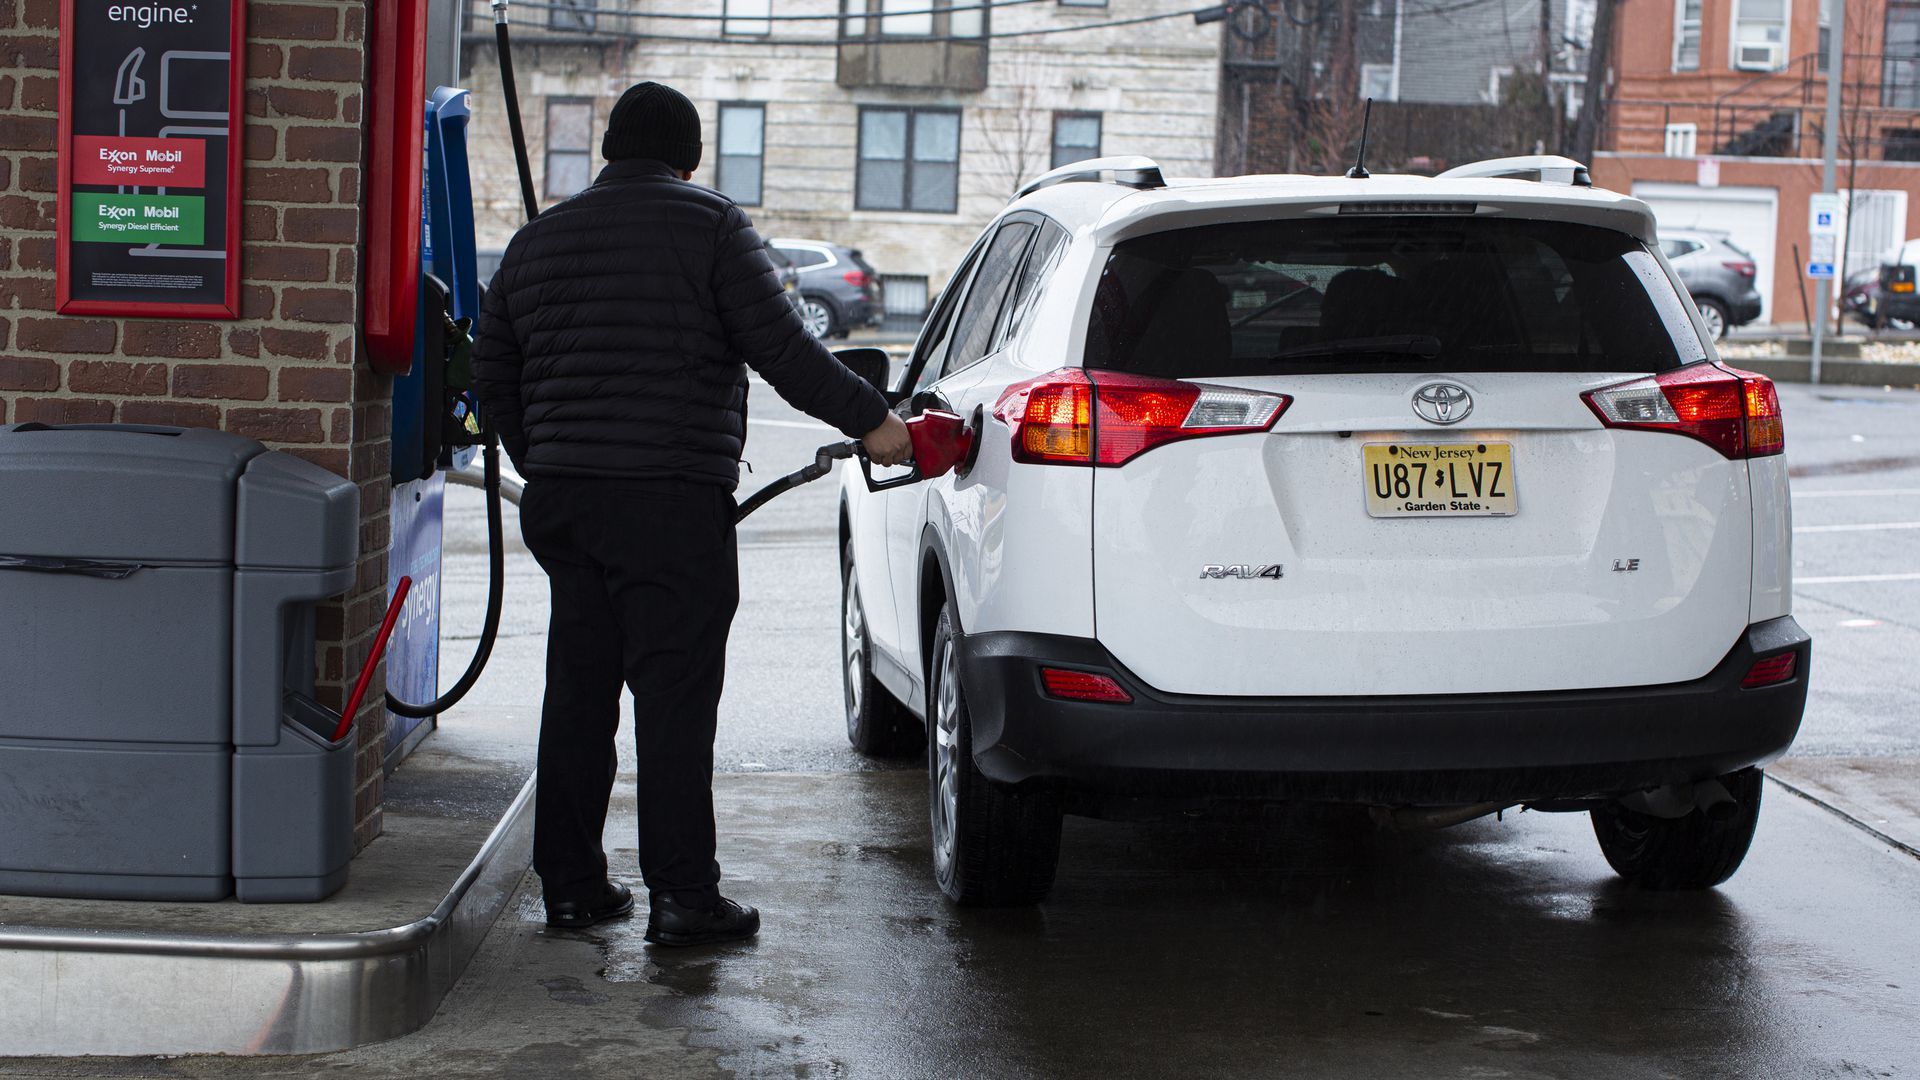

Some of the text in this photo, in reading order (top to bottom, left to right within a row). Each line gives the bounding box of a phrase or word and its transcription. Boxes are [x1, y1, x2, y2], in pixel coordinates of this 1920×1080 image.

[99, 148, 182, 164] Exxon Mobil
[107, 164, 138, 174] Synergy
[98, 204, 179, 220] Exxon Mobil
[98, 221, 179, 231] Synergy Diesel Efficient
[1400, 446, 1475, 461] New Jersey
[1373, 462, 1506, 499] U87 LVZ
[1404, 501, 1481, 511] Garden State
[1200, 563, 1283, 580] RAV4
[1611, 558, 1640, 571] LE
